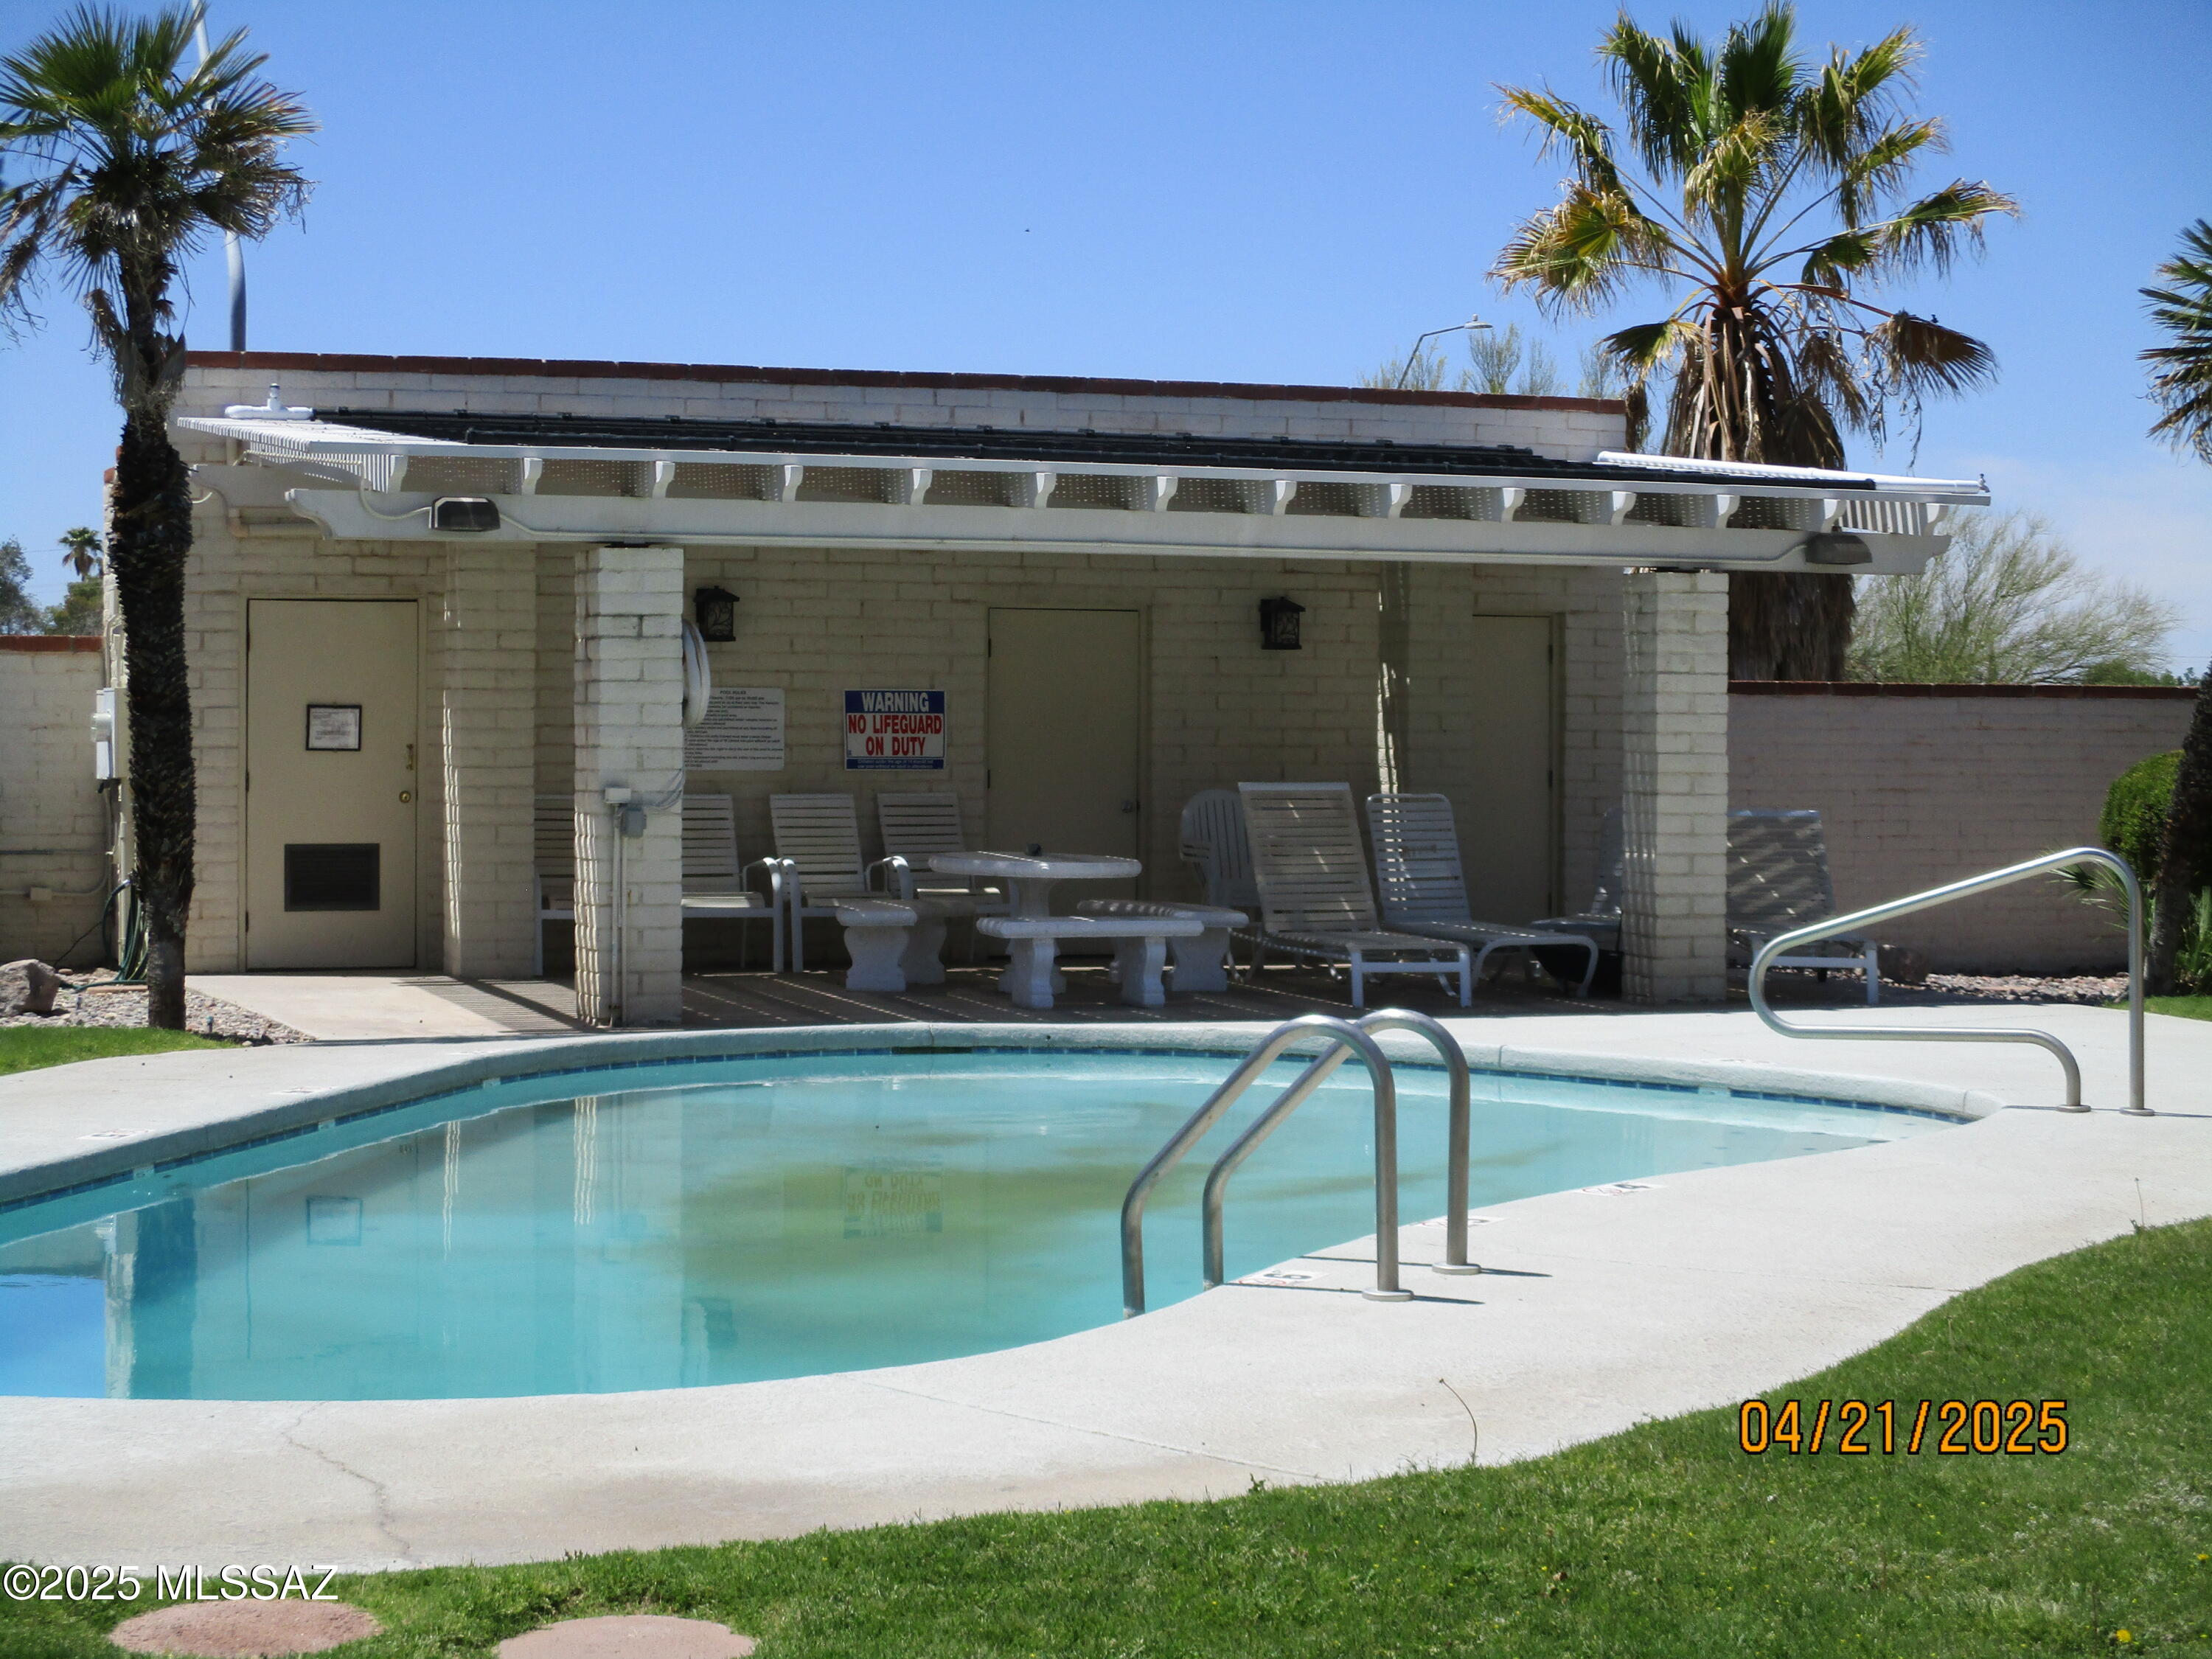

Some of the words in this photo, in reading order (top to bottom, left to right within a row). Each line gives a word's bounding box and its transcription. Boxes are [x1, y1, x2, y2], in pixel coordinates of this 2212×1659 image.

[861, 692, 930, 712] WARNING
[848, 714, 866, 734] NO
[873, 714, 942, 734] LIFEGUARD
[866, 736, 884, 756] ON
[892, 736, 925, 756] DUTY
